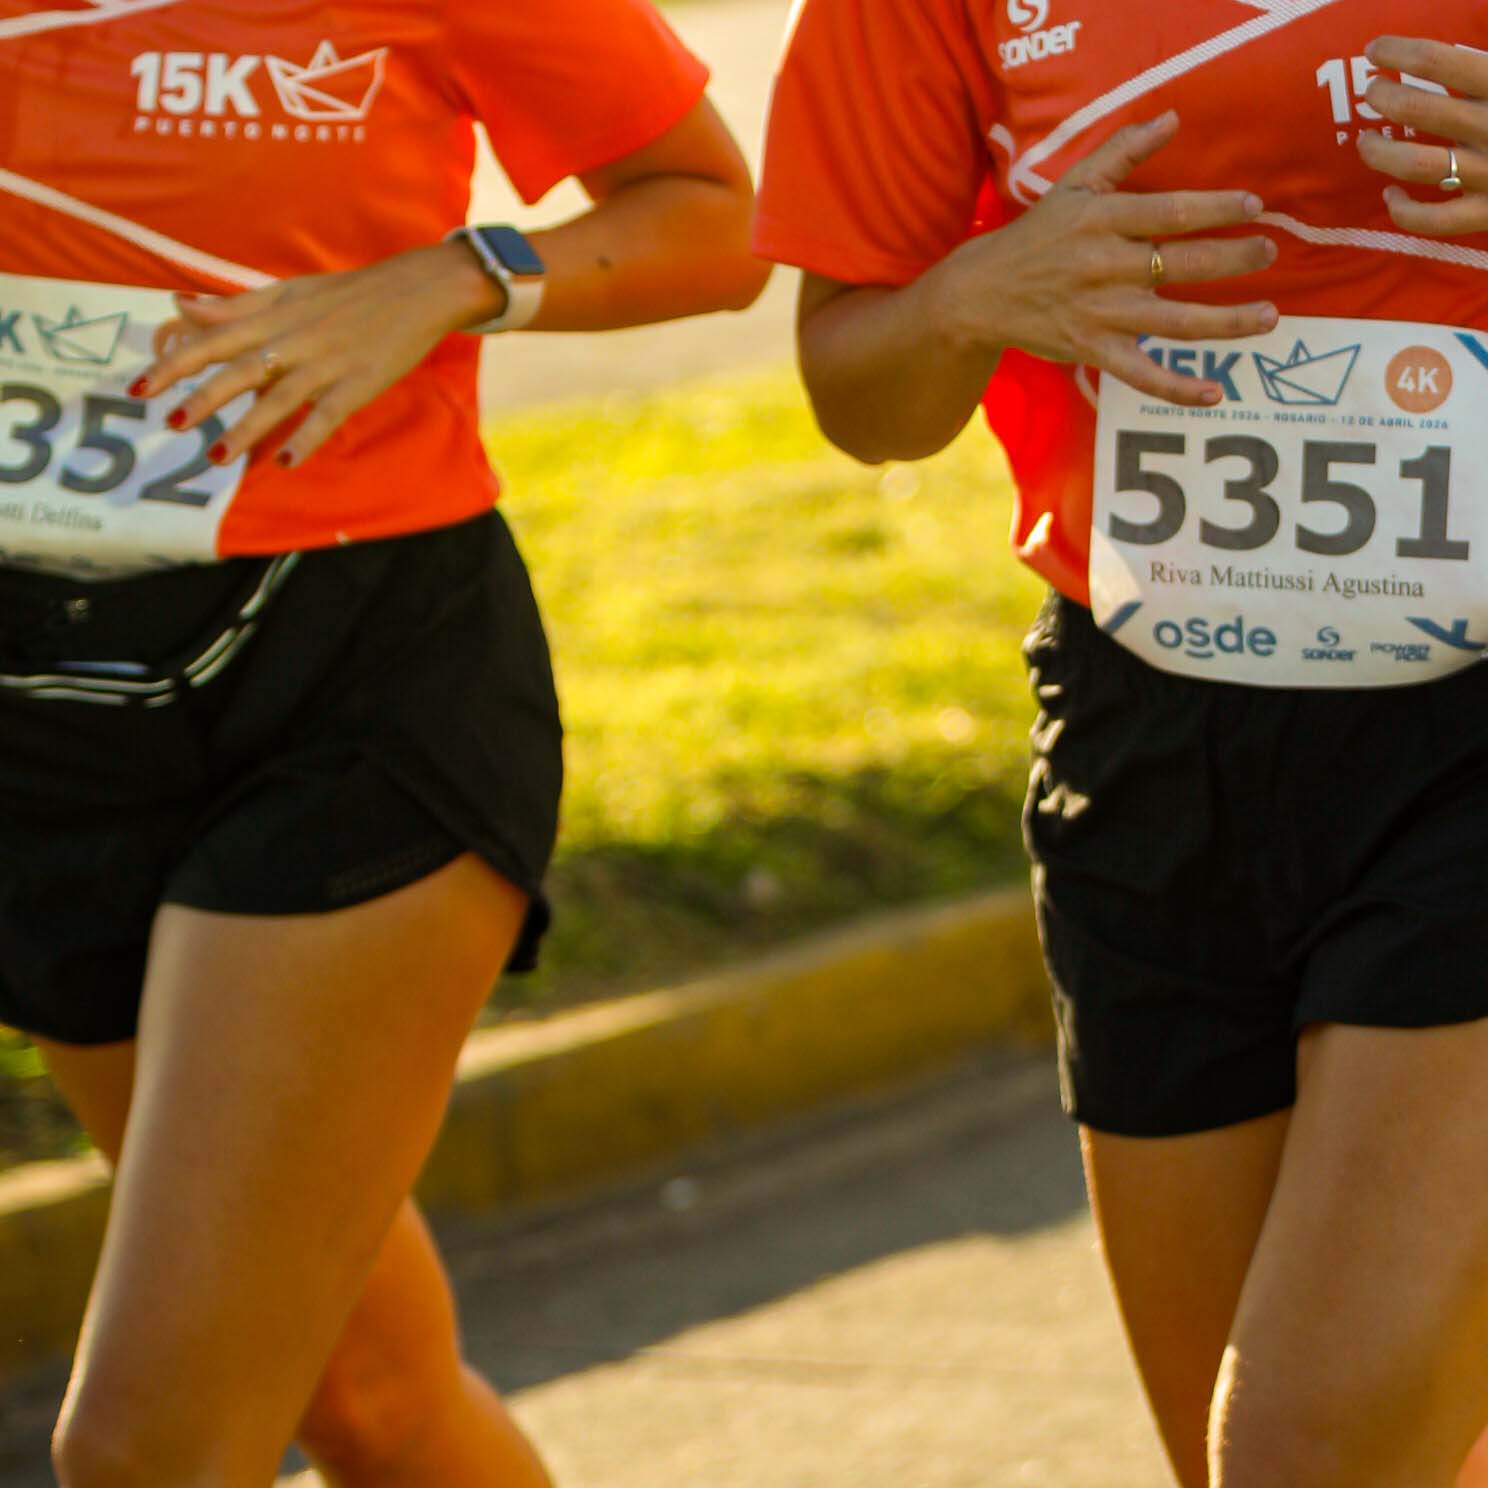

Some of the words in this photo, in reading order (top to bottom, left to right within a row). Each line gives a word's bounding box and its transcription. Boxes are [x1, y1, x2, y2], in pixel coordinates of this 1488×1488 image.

[131, 50, 261, 116] 15K
[134, 115, 263, 140] PUERTO
[271, 123, 366, 143] NORTE
[1396, 366, 1440, 394] 4K
[1358, 415, 1375, 427] DE
[1378, 416, 1414, 429] ABRIL
[1108, 429, 1470, 562] 5351
[1149, 561, 1202, 586] Riva
[1210, 564, 1314, 593] Mattiussi
[1322, 571, 1426, 599] Agustina
[1152, 615, 1278, 659] osde
